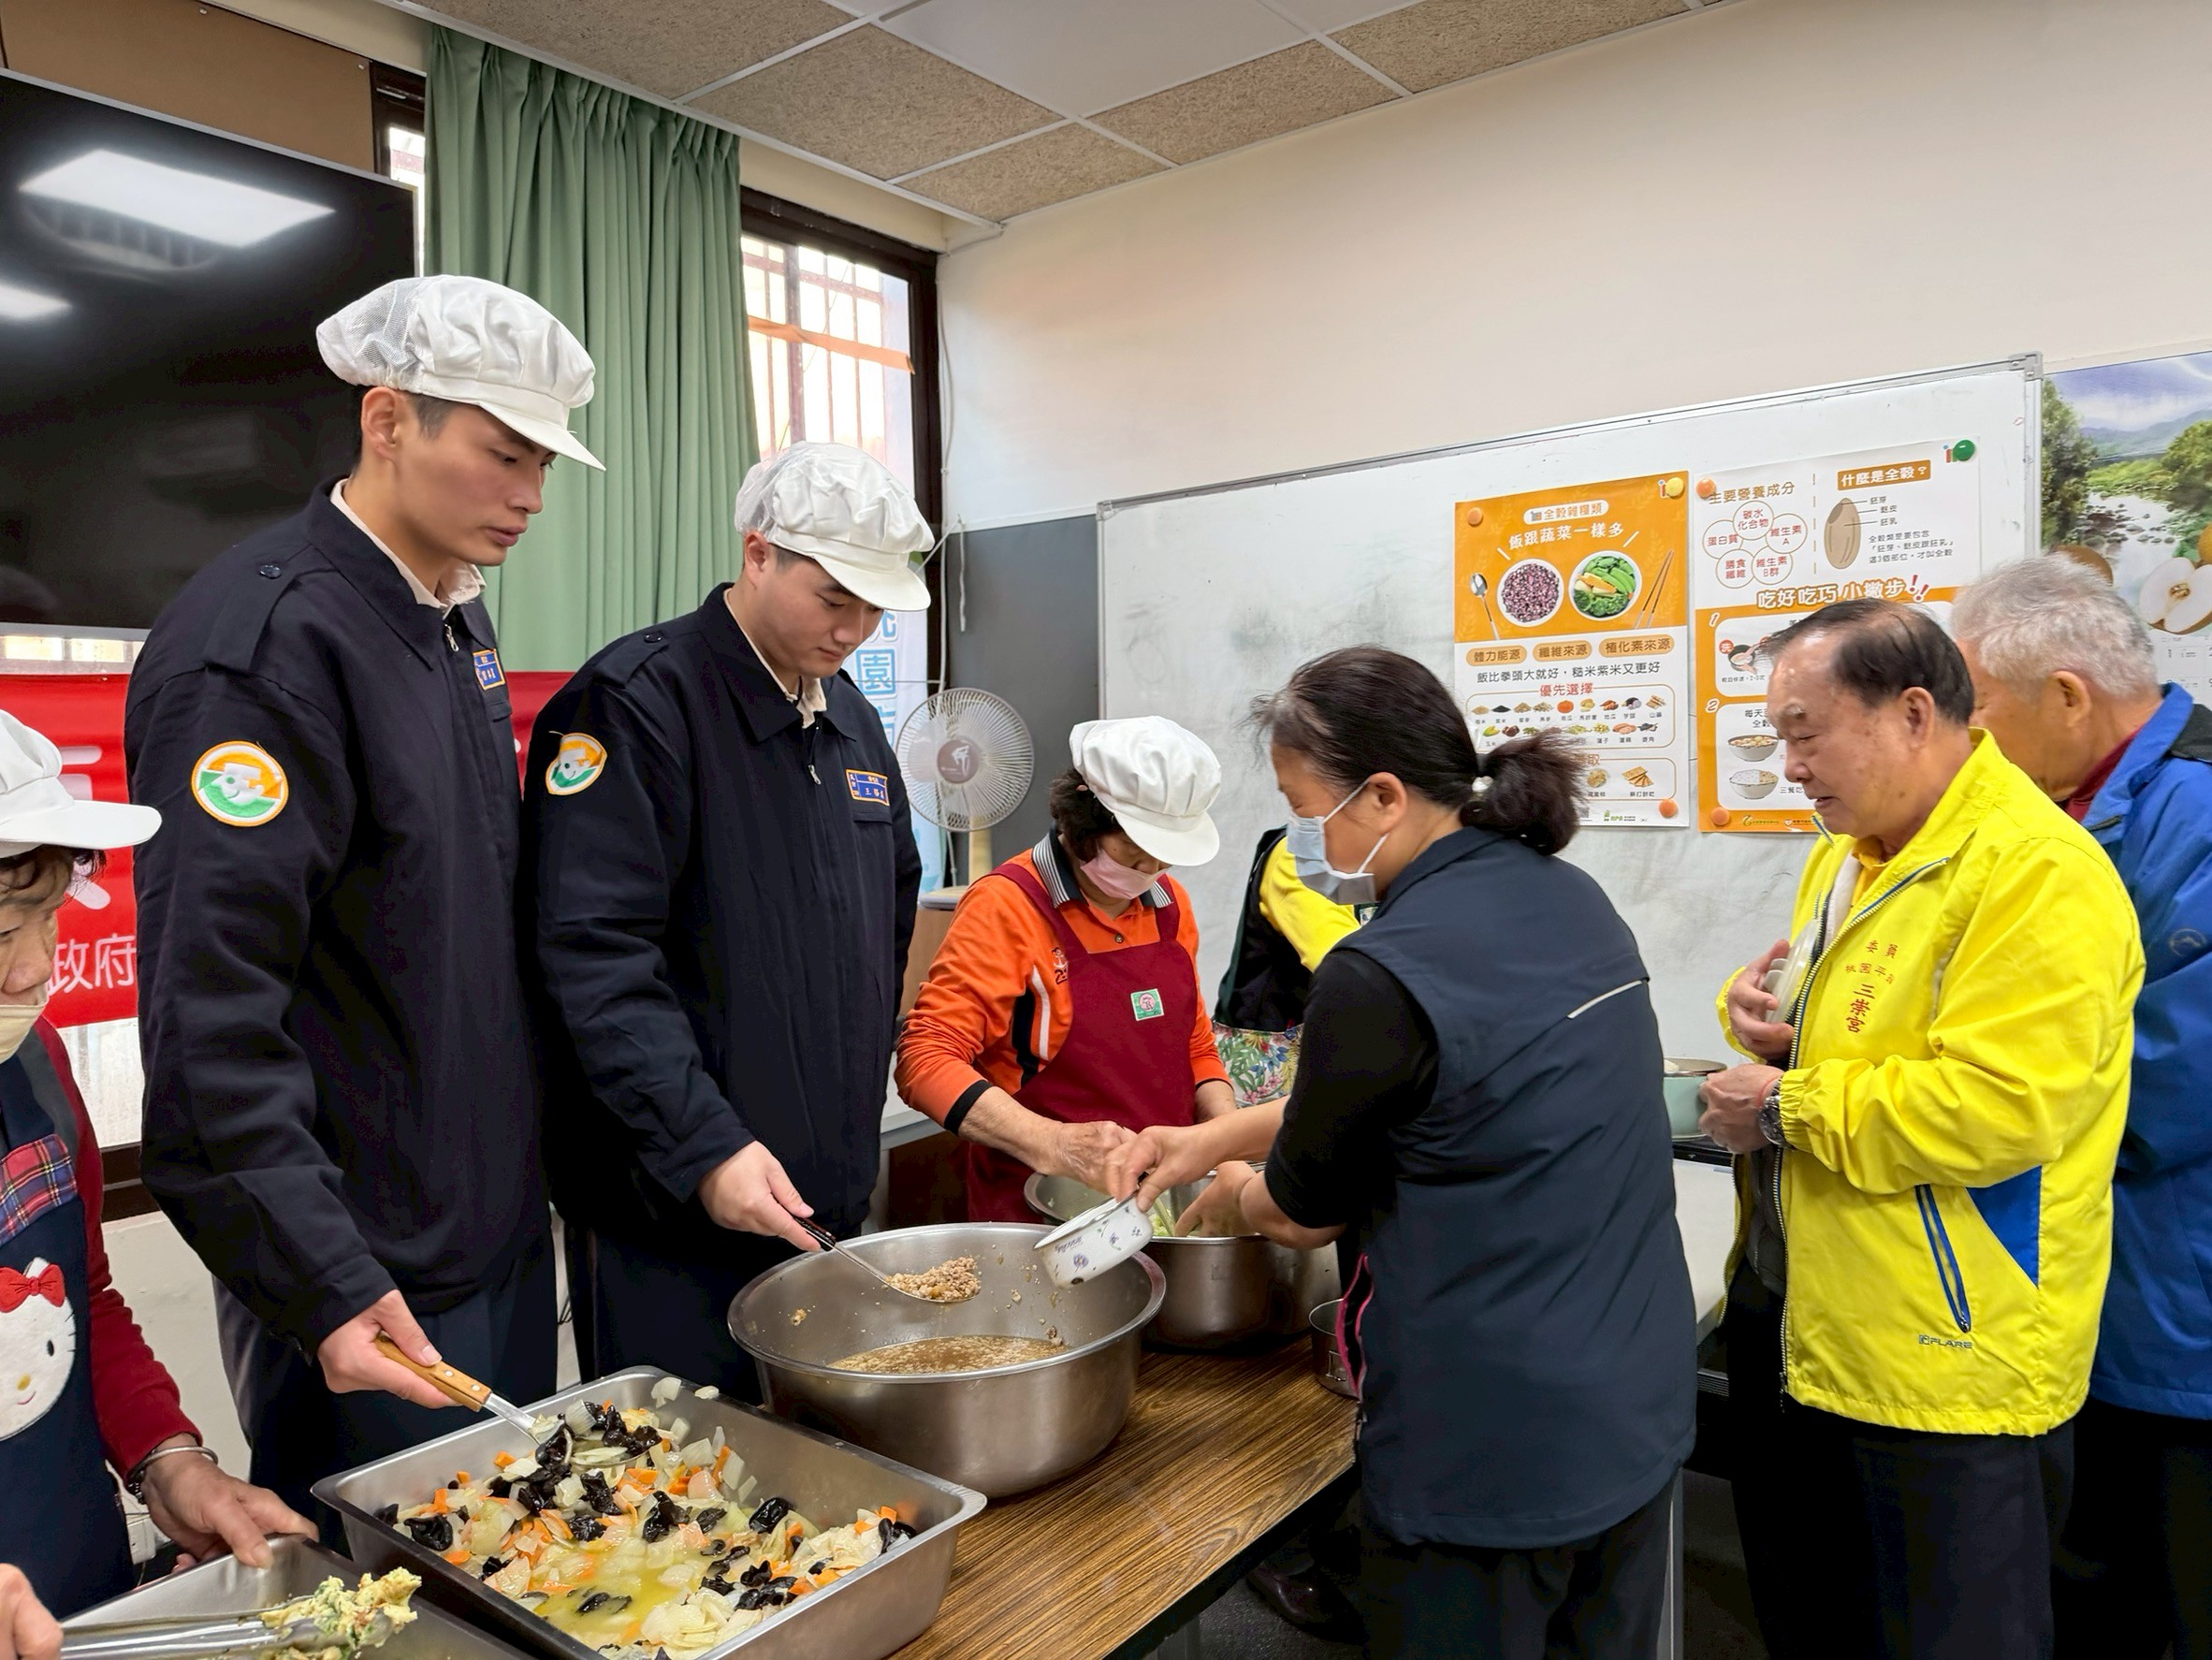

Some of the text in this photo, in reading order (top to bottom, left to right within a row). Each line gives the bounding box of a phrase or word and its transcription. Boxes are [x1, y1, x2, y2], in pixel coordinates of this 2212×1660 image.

[1709, 481, 1796, 504] 主要營養成分
[1544, 502, 1602, 520] 全穀雜糧類
[1742, 508, 1764, 520] 碳水
[1738, 518, 1769, 531] 化合物
[1508, 521, 1624, 550] 飯跟蔬菜一樣多
[1708, 533, 1739, 546] 蛋白質
[1537, 644, 1588, 658] 纖維來源
[1605, 637, 1671, 654] 植化素來源
[1474, 648, 1521, 663] 體力能源
[1539, 682, 1594, 697] 優先選擇
